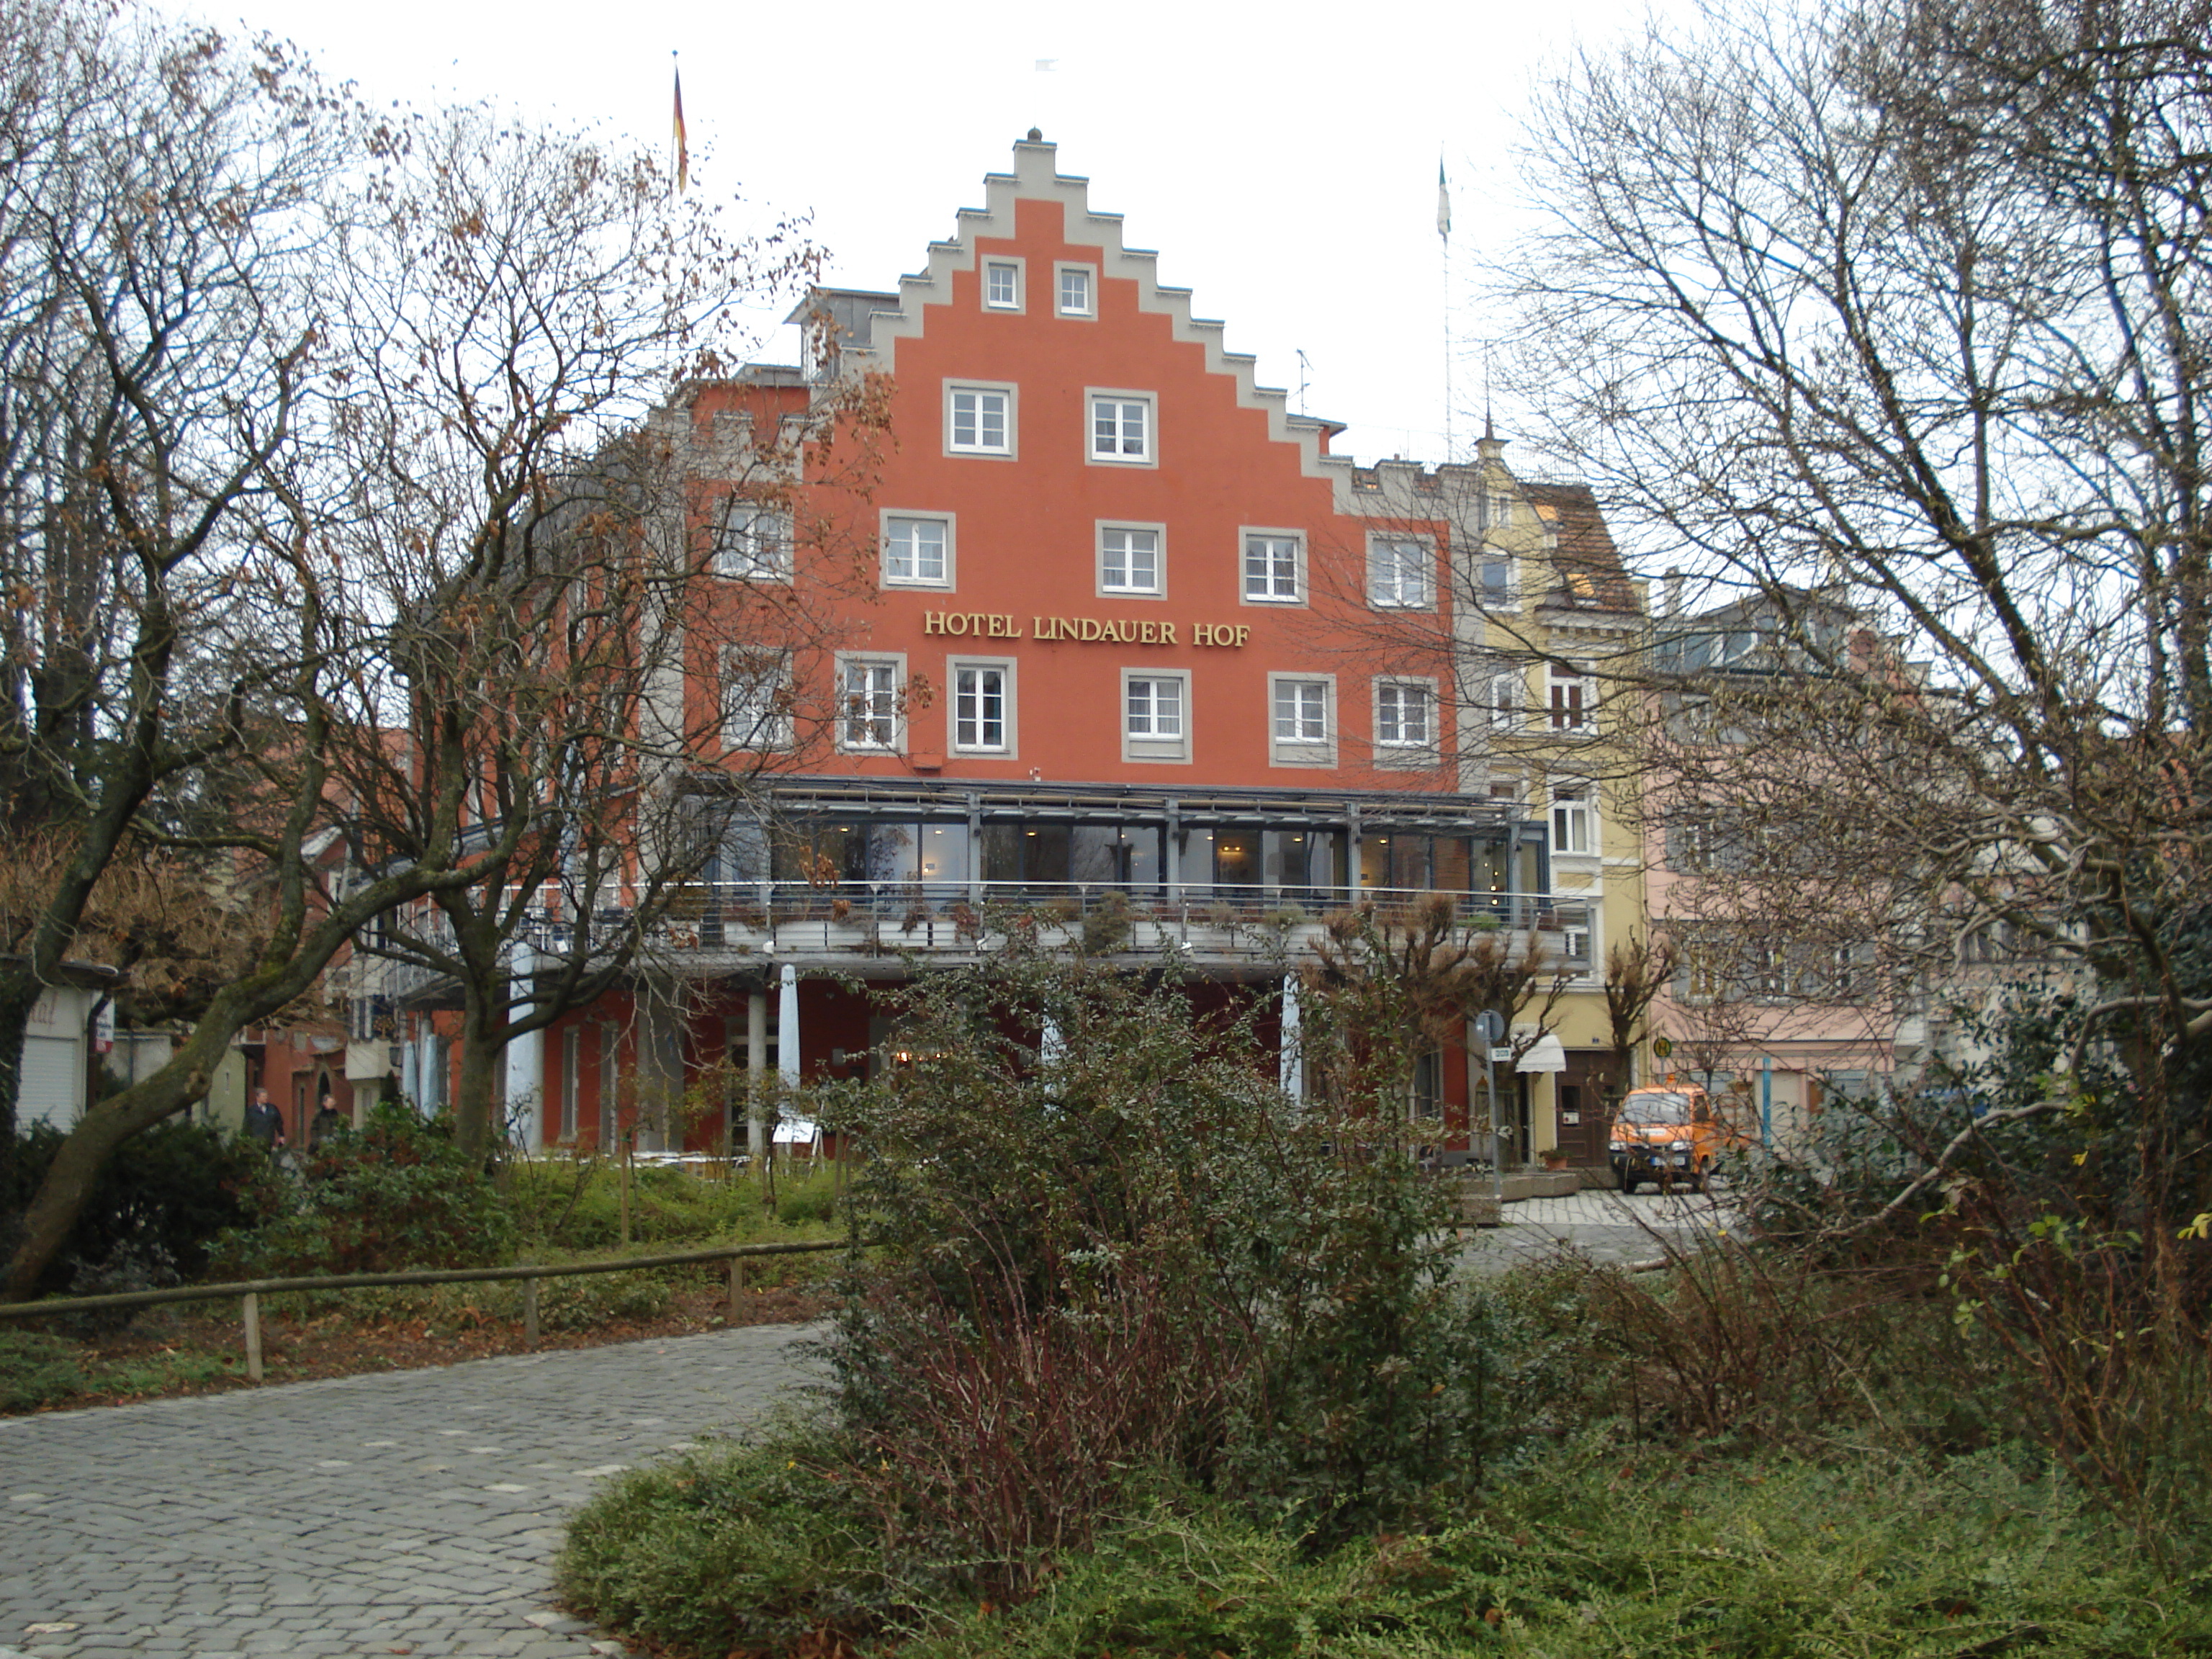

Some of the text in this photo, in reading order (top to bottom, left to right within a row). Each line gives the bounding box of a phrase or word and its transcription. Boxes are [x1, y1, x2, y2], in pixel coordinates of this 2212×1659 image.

[925, 611, 1251, 647] HOTEL LINDAUER HOF
